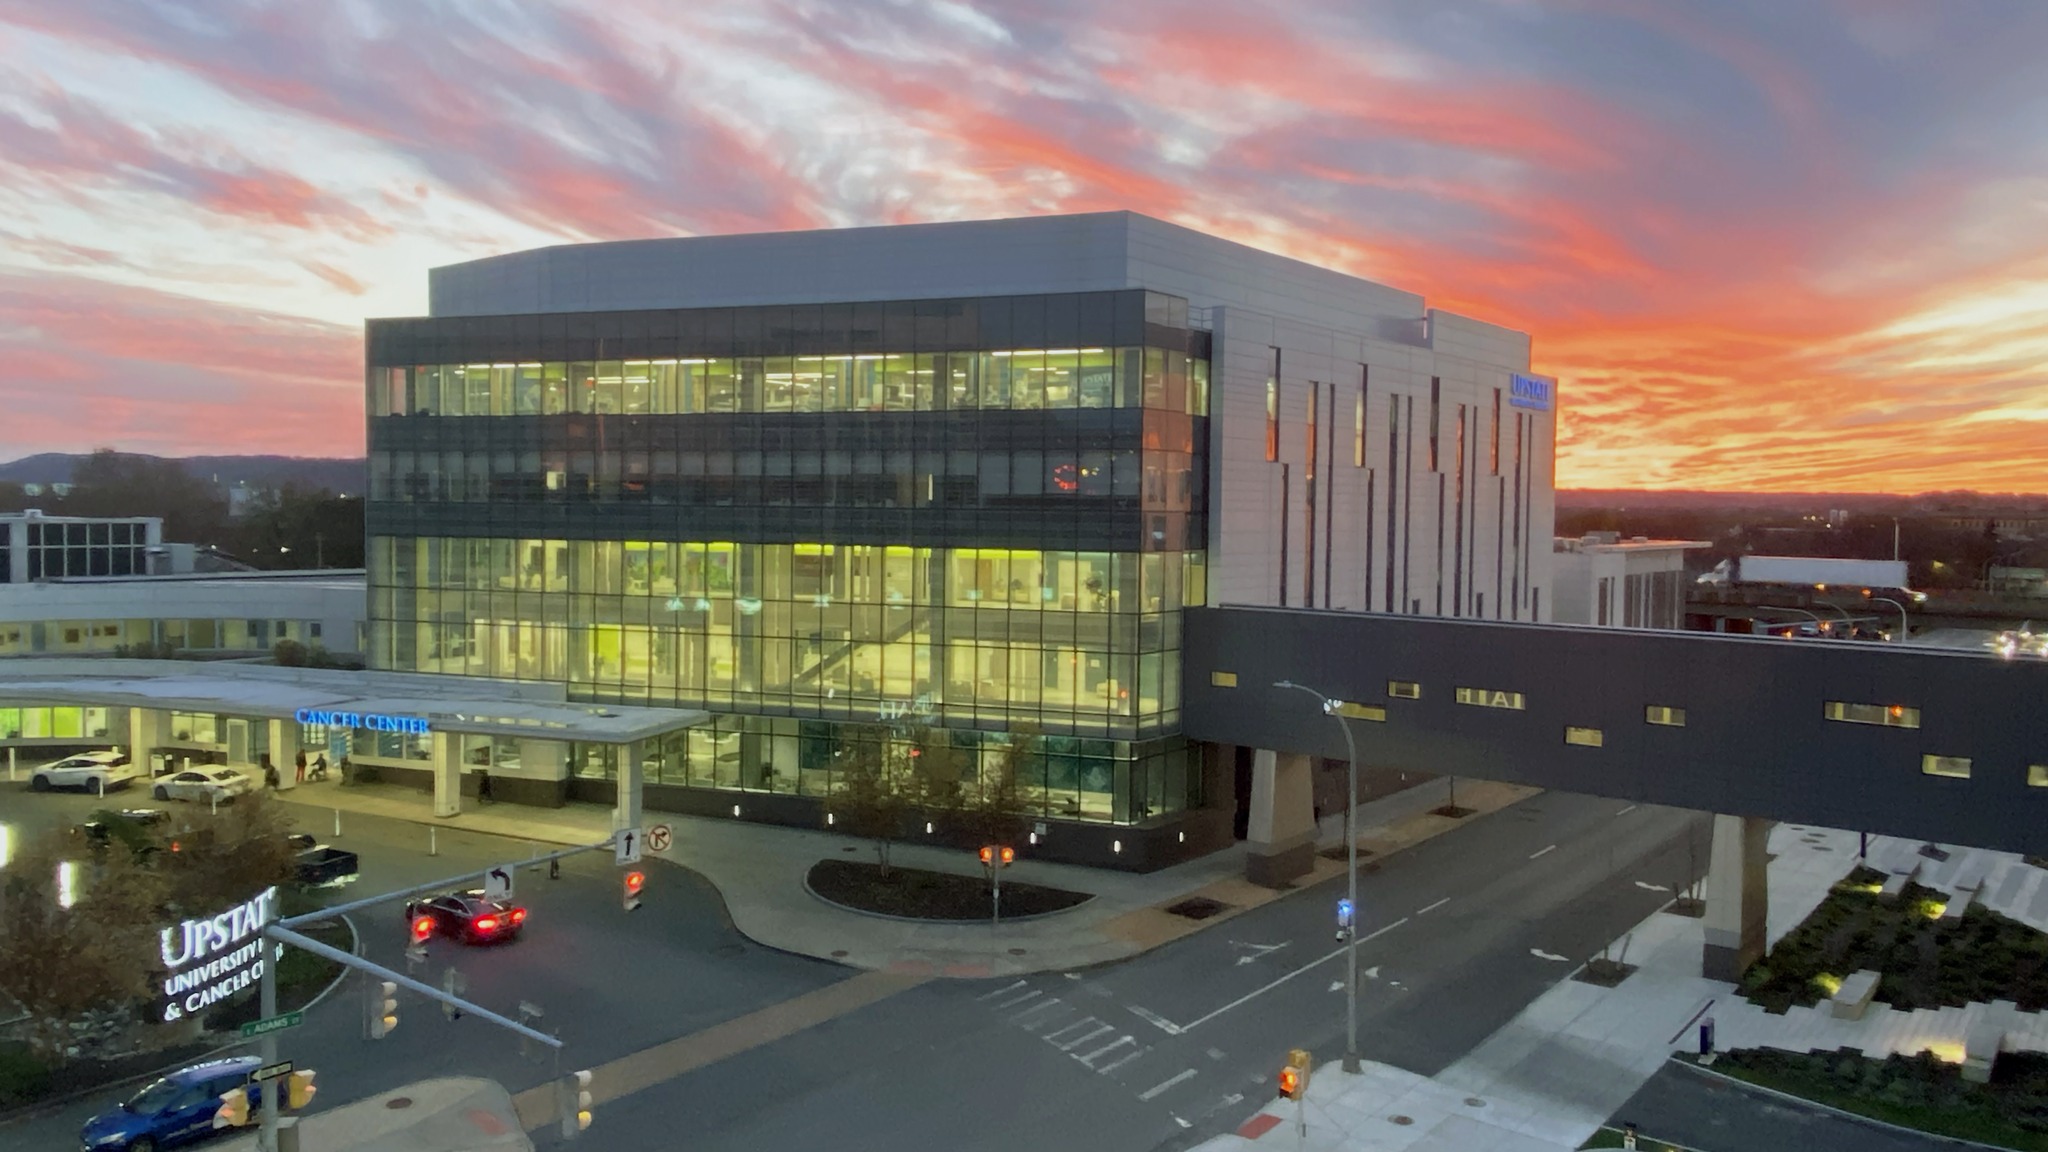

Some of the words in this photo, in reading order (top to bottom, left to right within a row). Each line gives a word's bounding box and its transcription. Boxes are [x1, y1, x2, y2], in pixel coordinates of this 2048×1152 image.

[296, 708, 360, 728] CANCER
[365, 714, 428, 734] CENTER
[161, 885, 277, 967] UPSTAT
[165, 940, 257, 996] UNIVERSITY
[164, 1002, 182, 1022] &
[185, 969, 250, 1013] CANCER
